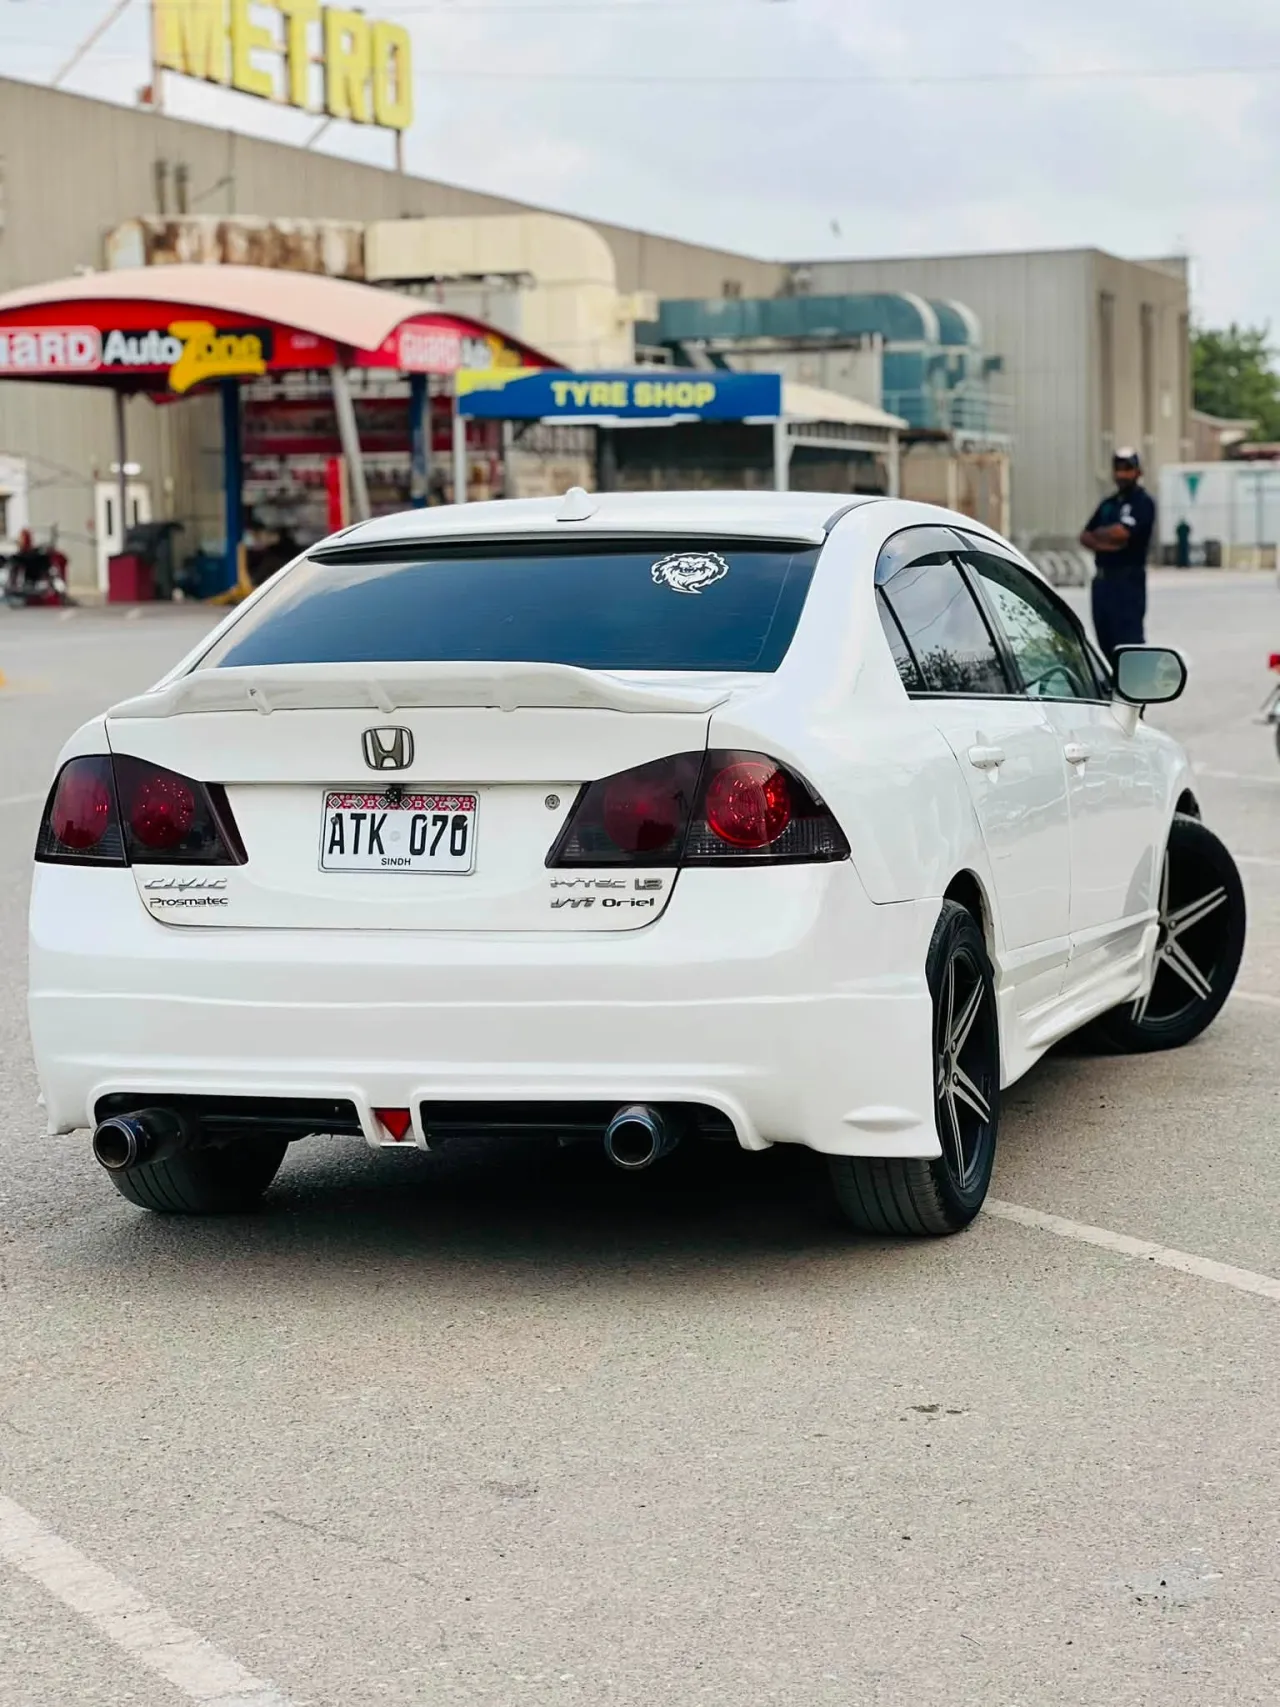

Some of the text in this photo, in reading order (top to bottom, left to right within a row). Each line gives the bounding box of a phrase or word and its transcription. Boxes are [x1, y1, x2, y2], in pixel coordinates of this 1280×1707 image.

[152, 0, 412, 130] METRO
[552, 381, 716, 408] TYRE SHOP
[328, 812, 468, 857] ATK 070
[381, 857, 411, 866] SINDH
[144, 878, 228, 892] CIVIC
[149, 896, 228, 908] Prosmatec
[602, 897, 655, 908] Oriel
